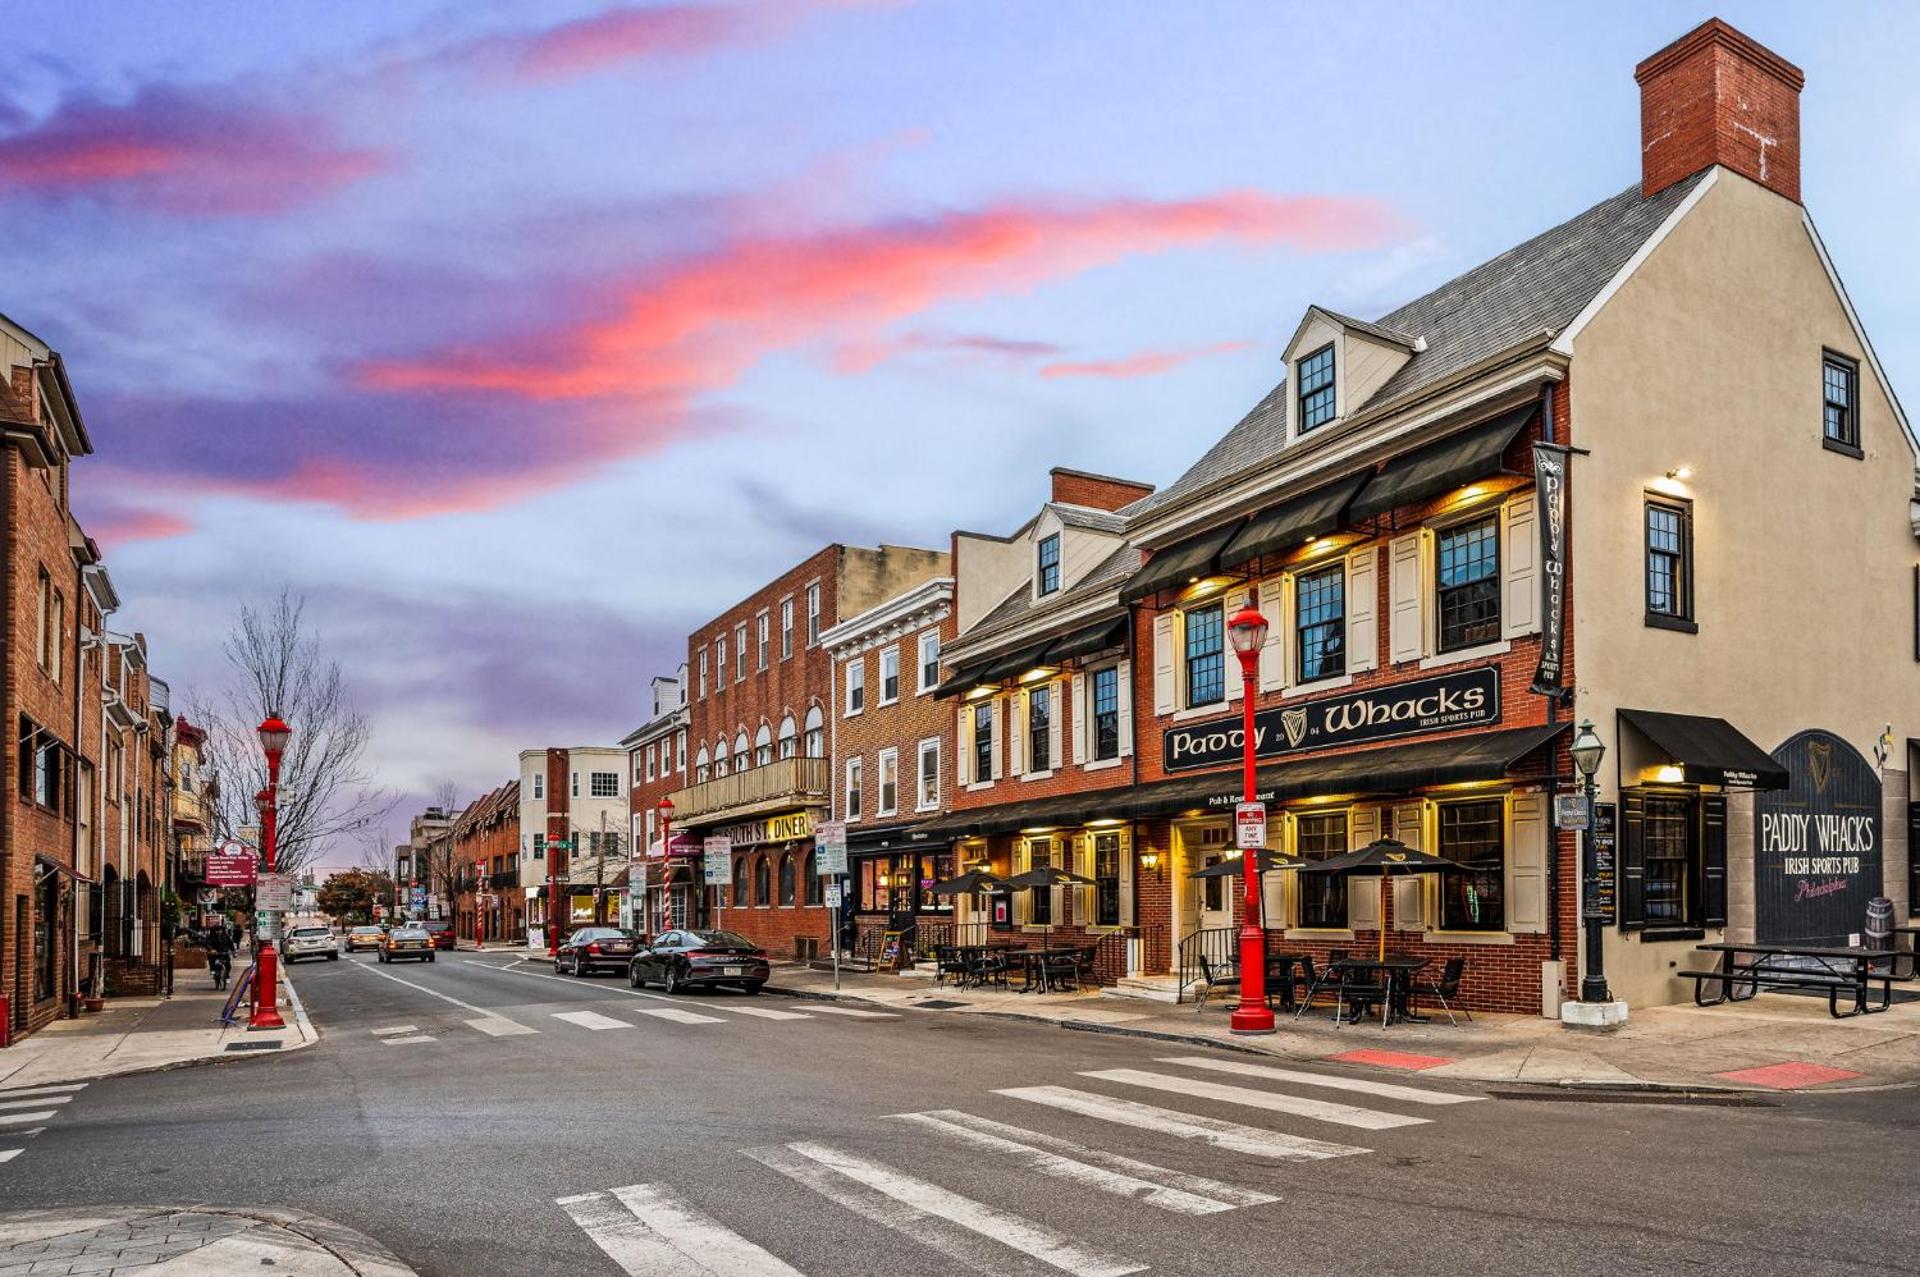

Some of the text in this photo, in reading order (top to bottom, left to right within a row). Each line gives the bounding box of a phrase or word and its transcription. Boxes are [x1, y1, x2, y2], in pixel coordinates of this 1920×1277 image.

[1325, 687, 1485, 733] Whacks
[1440, 712, 1469, 724] SPORTS
[1470, 709, 1486, 719] PUB
[774, 815, 806, 838] DINER
[1762, 814, 1874, 852] PADDY WHACKS
[1784, 857, 1860, 875] IRISH SPORTS PUB
[1794, 877, 1848, 902] Philadelphia
